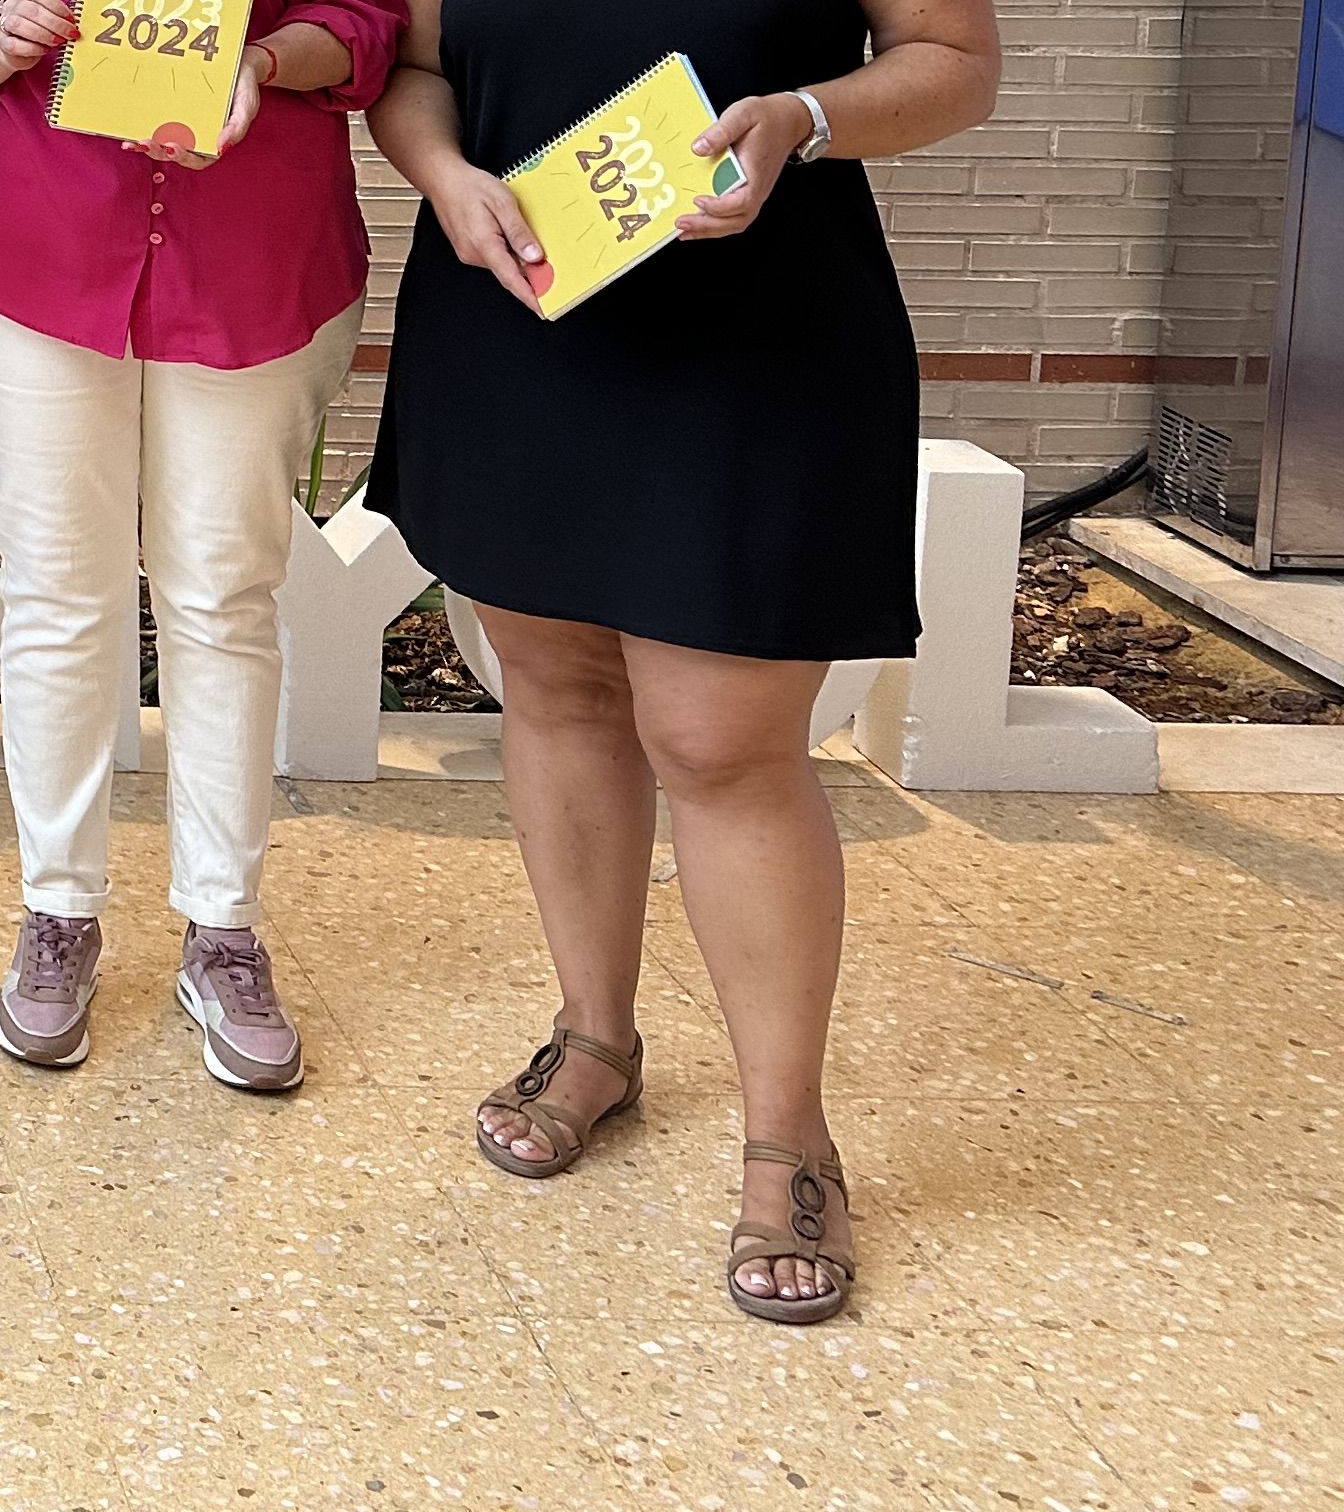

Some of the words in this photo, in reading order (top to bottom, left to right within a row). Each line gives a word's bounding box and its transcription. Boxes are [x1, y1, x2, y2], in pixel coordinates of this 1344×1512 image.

[94, 8, 220, 62] 2024
[576, 135, 651, 243] 2024
[611, 115, 676, 221] 2023
